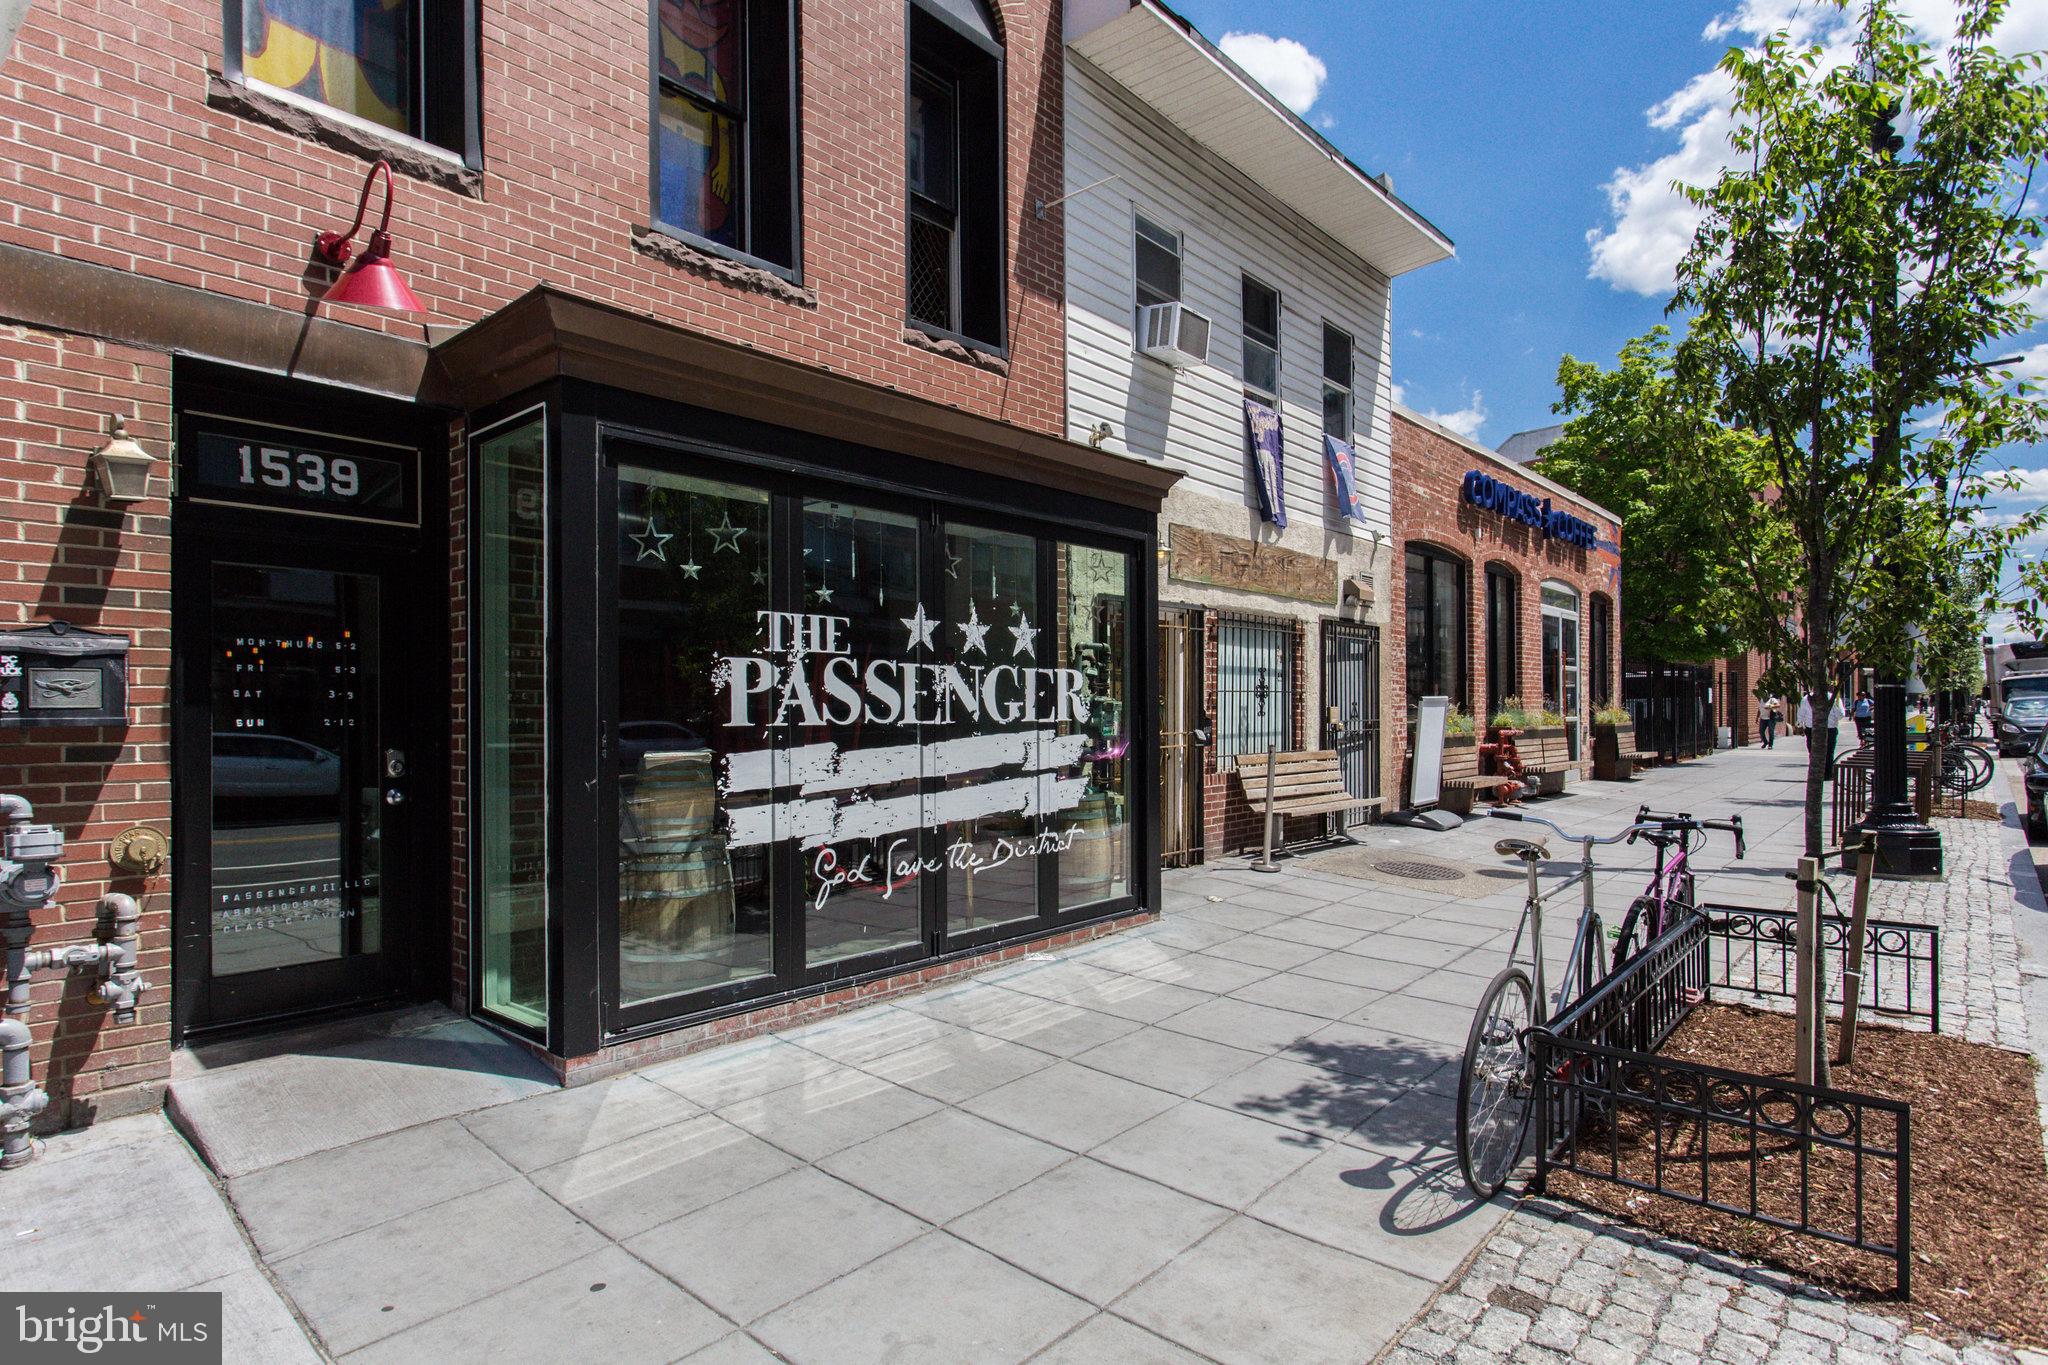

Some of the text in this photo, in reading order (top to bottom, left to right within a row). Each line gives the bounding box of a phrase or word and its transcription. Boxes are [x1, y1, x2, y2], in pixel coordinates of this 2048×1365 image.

[239, 445, 359, 496] 1539
[1464, 470, 1597, 549] COMPASS COFFEE
[757, 610, 851, 654] THE
[335, 642, 357, 650] 5-2
[0, 667, 23, 676] UCK
[236, 664, 356, 674] FRI 5-3
[233, 689, 262, 698] SAT
[720, 656, 1090, 728] PASSENGER
[236, 719, 264, 727] SUN
[814, 848, 872, 910] God
[882, 838, 943, 900] Save
[974, 822, 1085, 874] District
[222, 885, 316, 903] PASSENGER
[344, 879, 371, 889] LLC
[223, 920, 275, 933] CLASS
[285, 917, 293, 925] C
